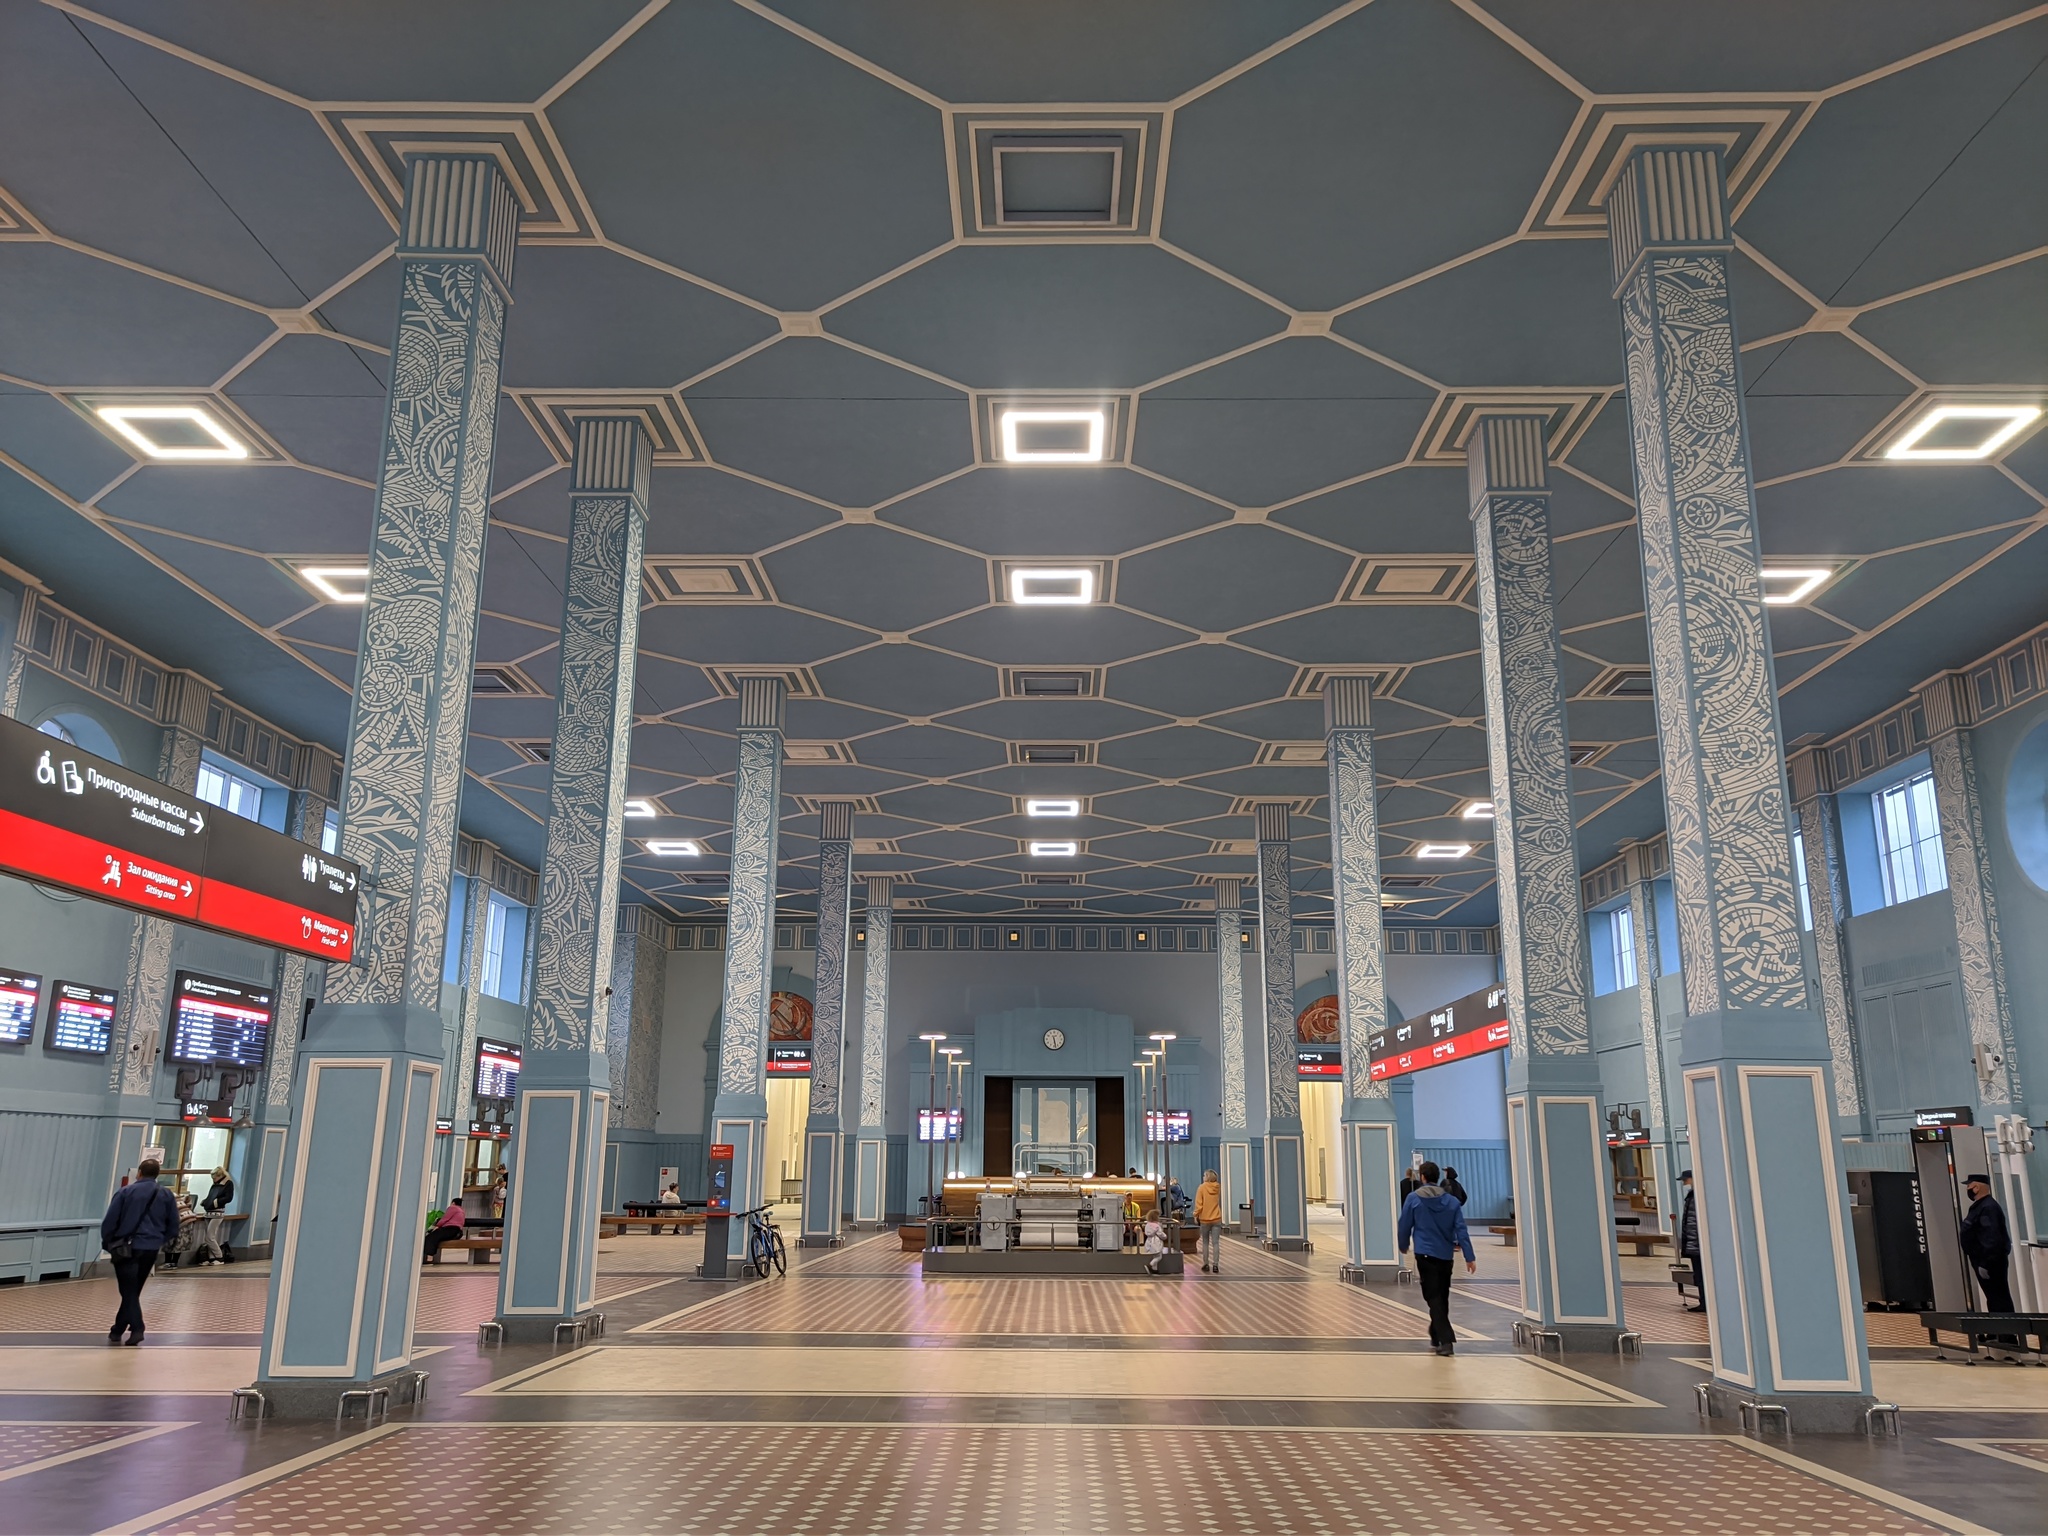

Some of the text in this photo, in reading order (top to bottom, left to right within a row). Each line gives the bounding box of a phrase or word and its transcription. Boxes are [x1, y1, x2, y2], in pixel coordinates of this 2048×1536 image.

[88, 767, 187, 820] Пригородные кассы
[131, 807, 186, 837] Suburban trains
[127, 861, 179, 888] Зал ожидания
[319, 859, 346, 880] Туалеты
[144, 884, 176, 901] Sitting area
[328, 880, 344, 894] Toilets
[313, 920, 340, 936] Медпункт
